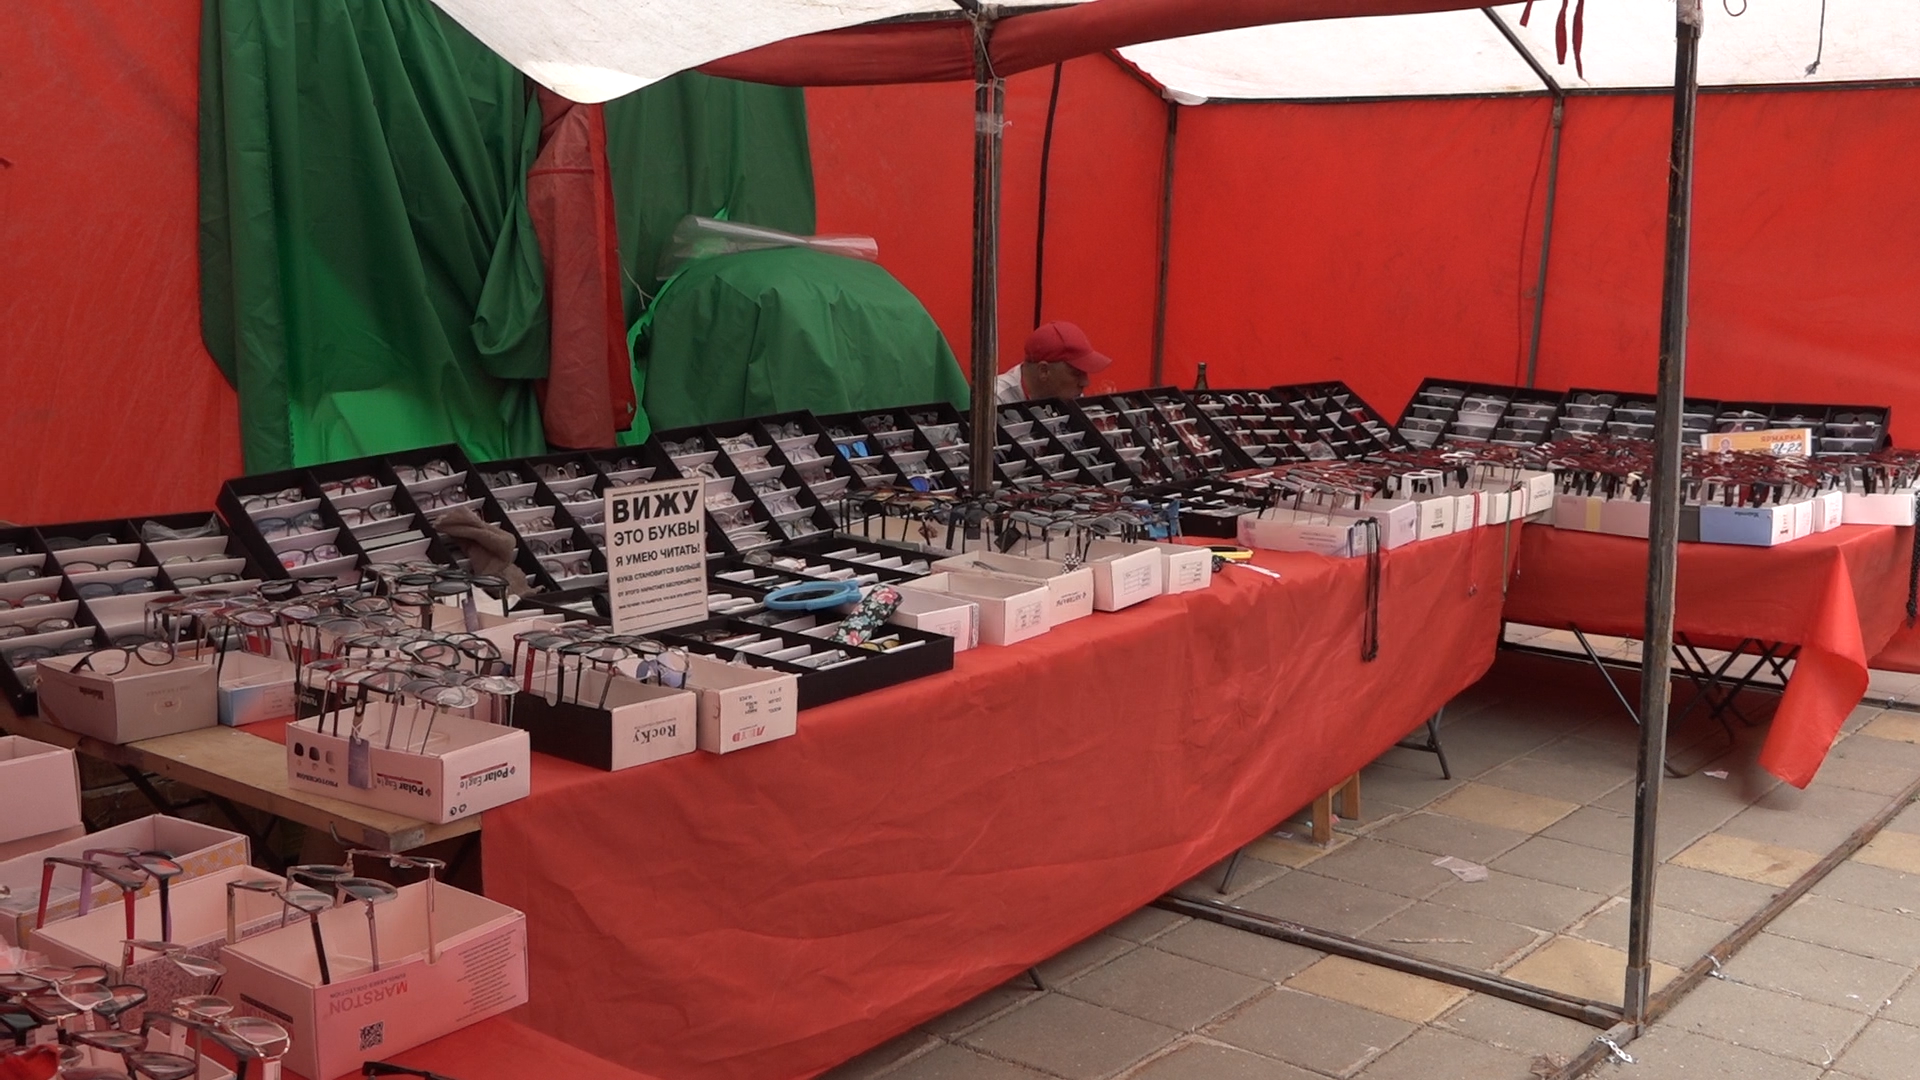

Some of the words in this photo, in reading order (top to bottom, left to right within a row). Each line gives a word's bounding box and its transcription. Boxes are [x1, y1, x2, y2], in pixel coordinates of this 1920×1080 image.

[1760, 434, 1802, 442] ЯРМАРКА
[612, 489, 699, 524] ВИЖУ
[613, 528, 644, 546] ЭТО
[648, 520, 700, 541] БУКВЫ
[616, 554, 623, 567] Я
[625, 549, 658, 565] УМЕЮ
[660, 543, 700, 560] ЧИТАТЬ!
[634, 567, 675, 581] СТАНОВИТСЯ
[459, 773, 483, 791] Eagle
[484, 768, 509, 783] Polar
[376, 777, 398, 791] Eagle
[399, 782, 424, 796] Polar
[329, 983, 368, 998] COLLECTION
[329, 981, 408, 1015] MARSTON
